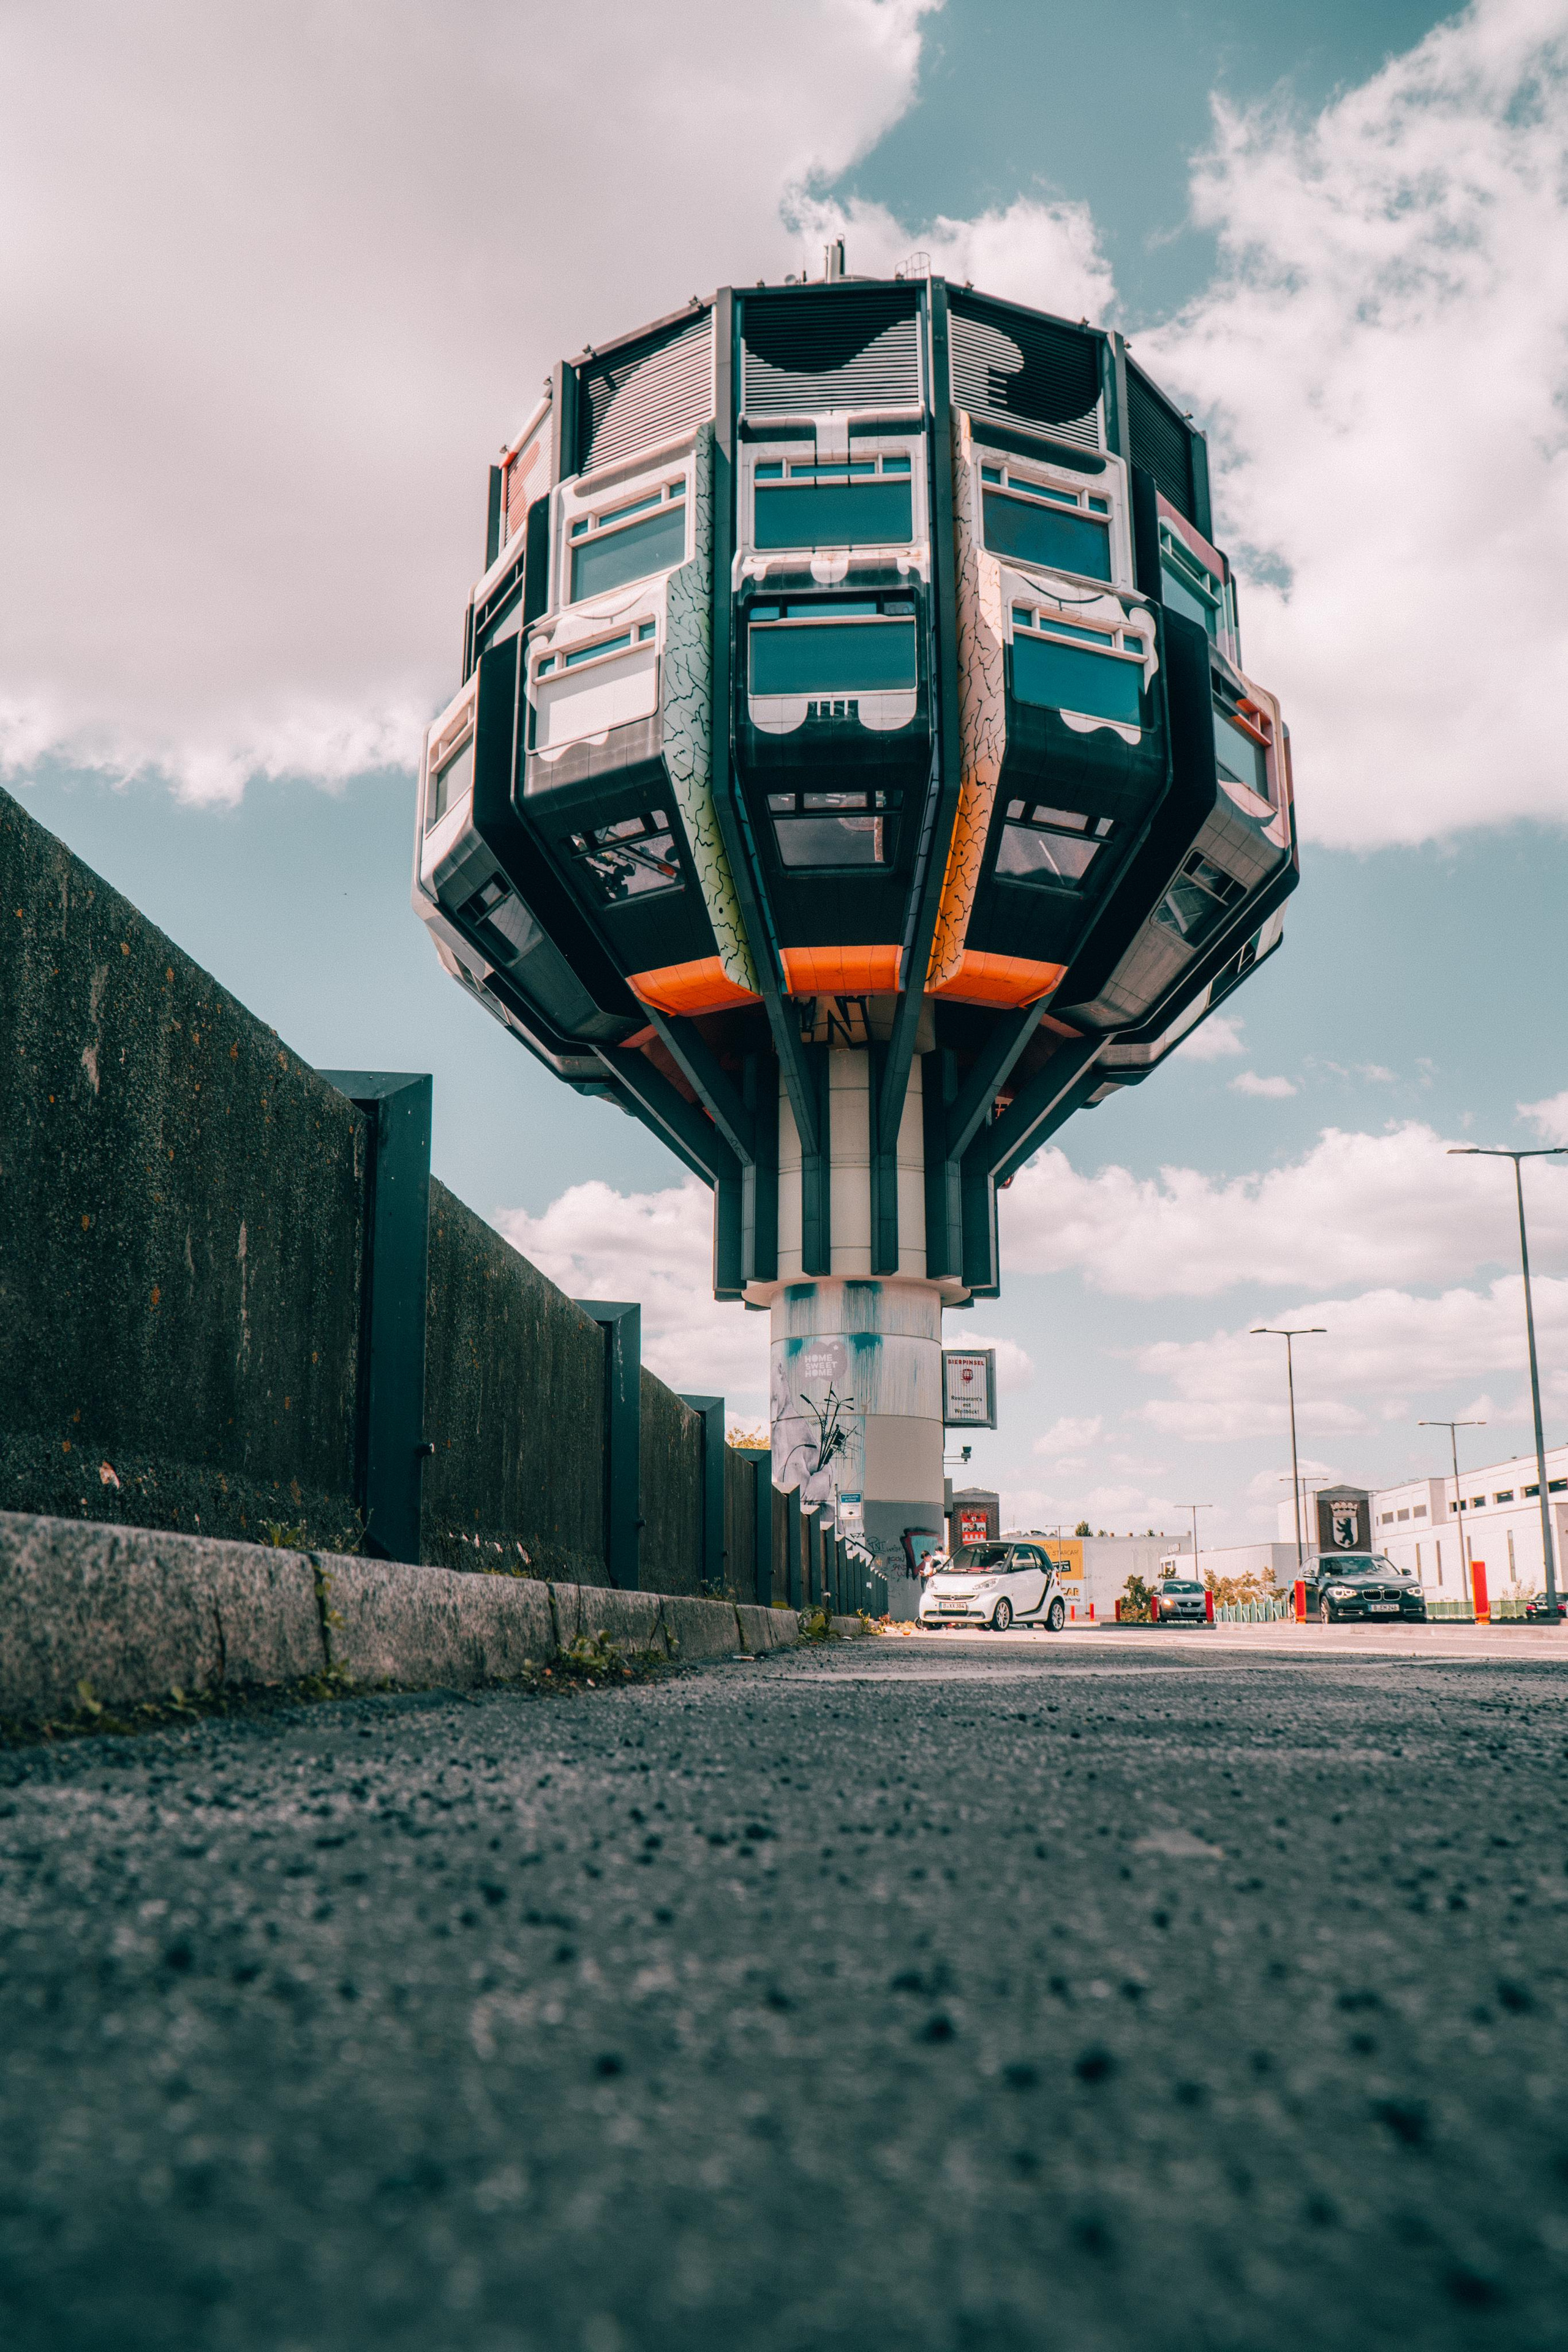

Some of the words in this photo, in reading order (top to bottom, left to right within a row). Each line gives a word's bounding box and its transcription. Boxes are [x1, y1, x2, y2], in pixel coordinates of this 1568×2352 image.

[804, 1354, 832, 1363] HOME
[805, 1361, 838, 1370] SWEET
[805, 1368, 832, 1378] HOME
